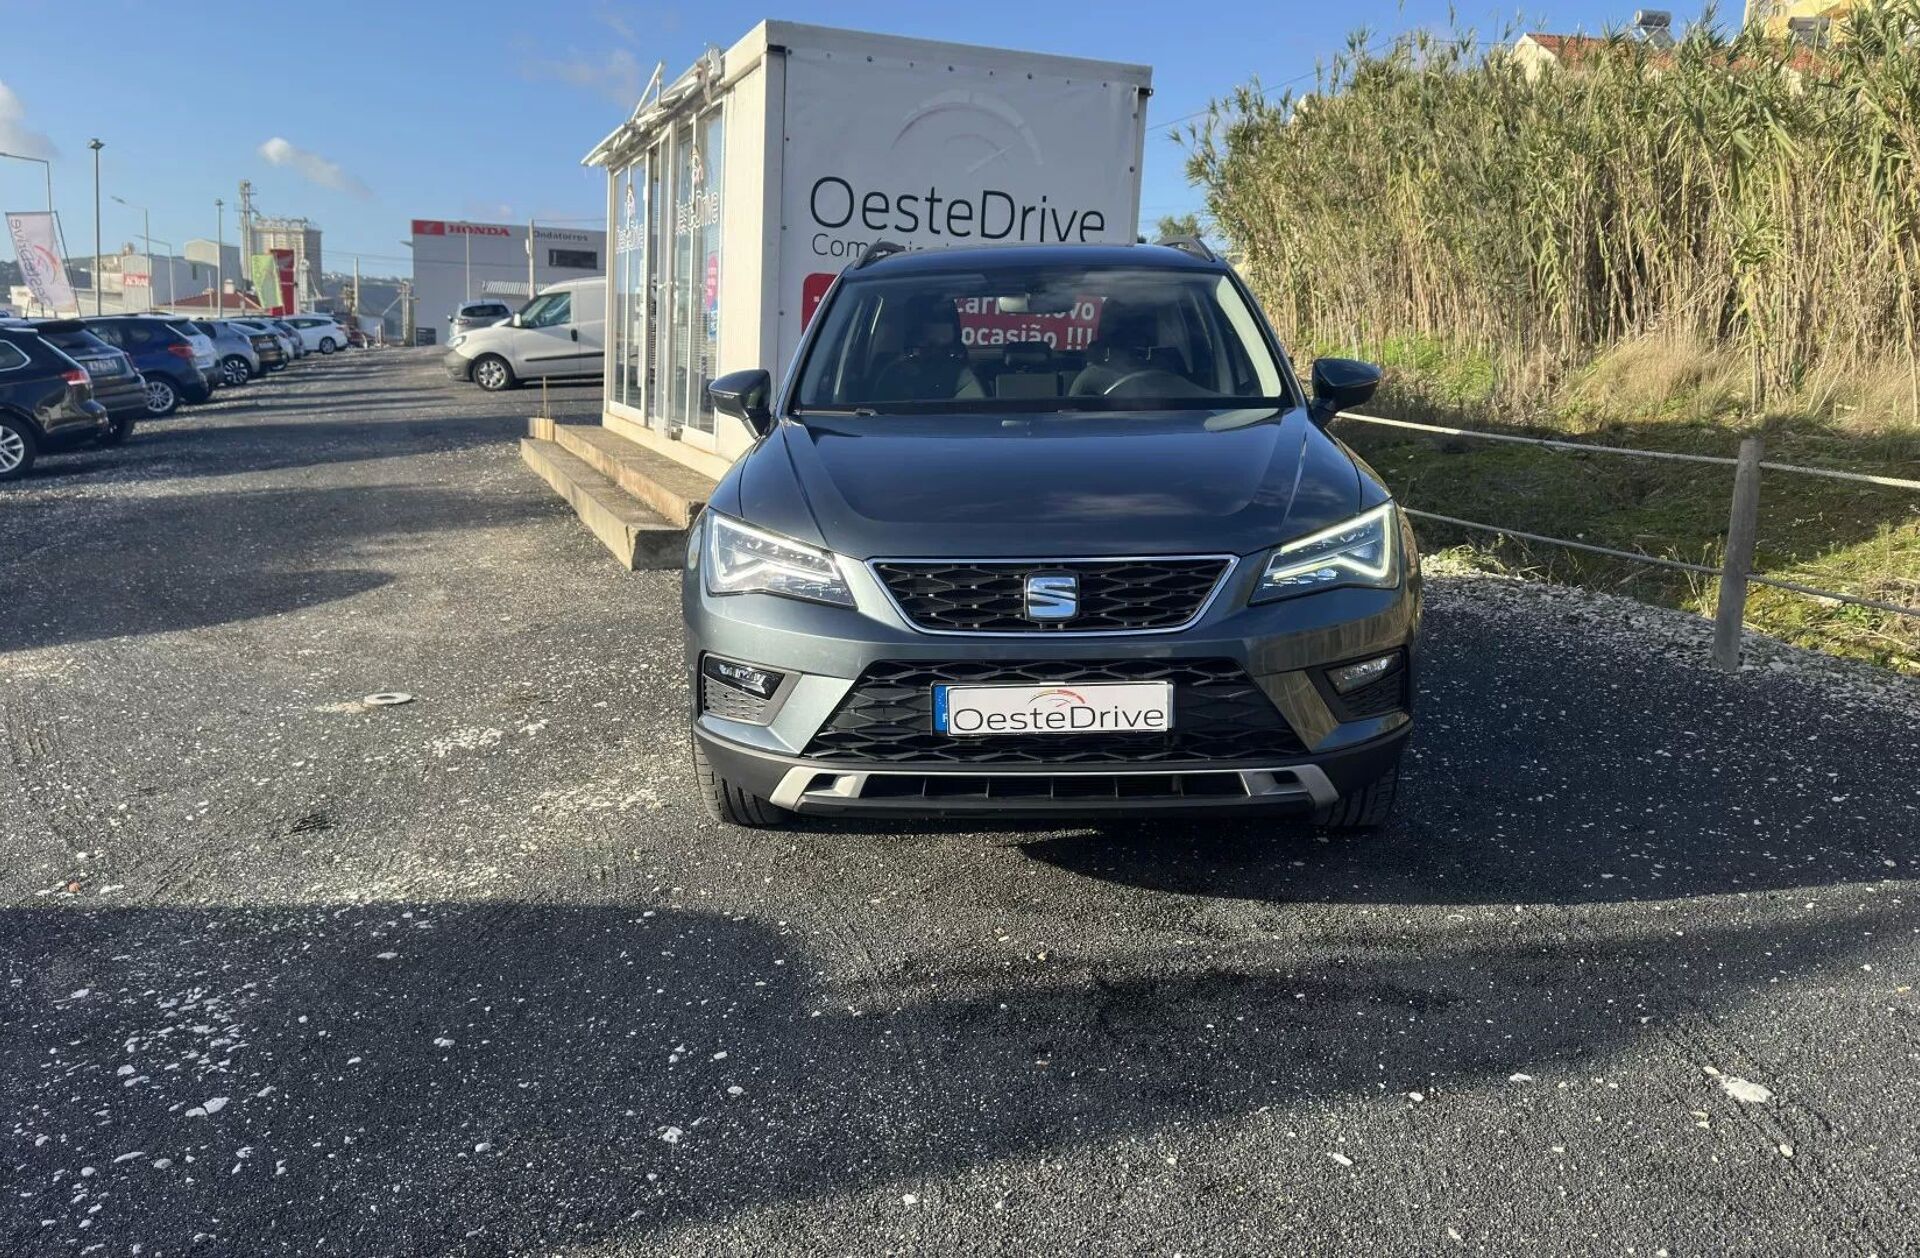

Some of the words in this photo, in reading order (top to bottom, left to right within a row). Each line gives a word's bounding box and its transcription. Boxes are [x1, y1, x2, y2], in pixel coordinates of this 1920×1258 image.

[809, 176, 1105, 243] OesteDrive
[448, 224, 510, 237] HONDA
[961, 324, 1057, 350] ocasião
[953, 705, 1164, 731] OesteDrive
